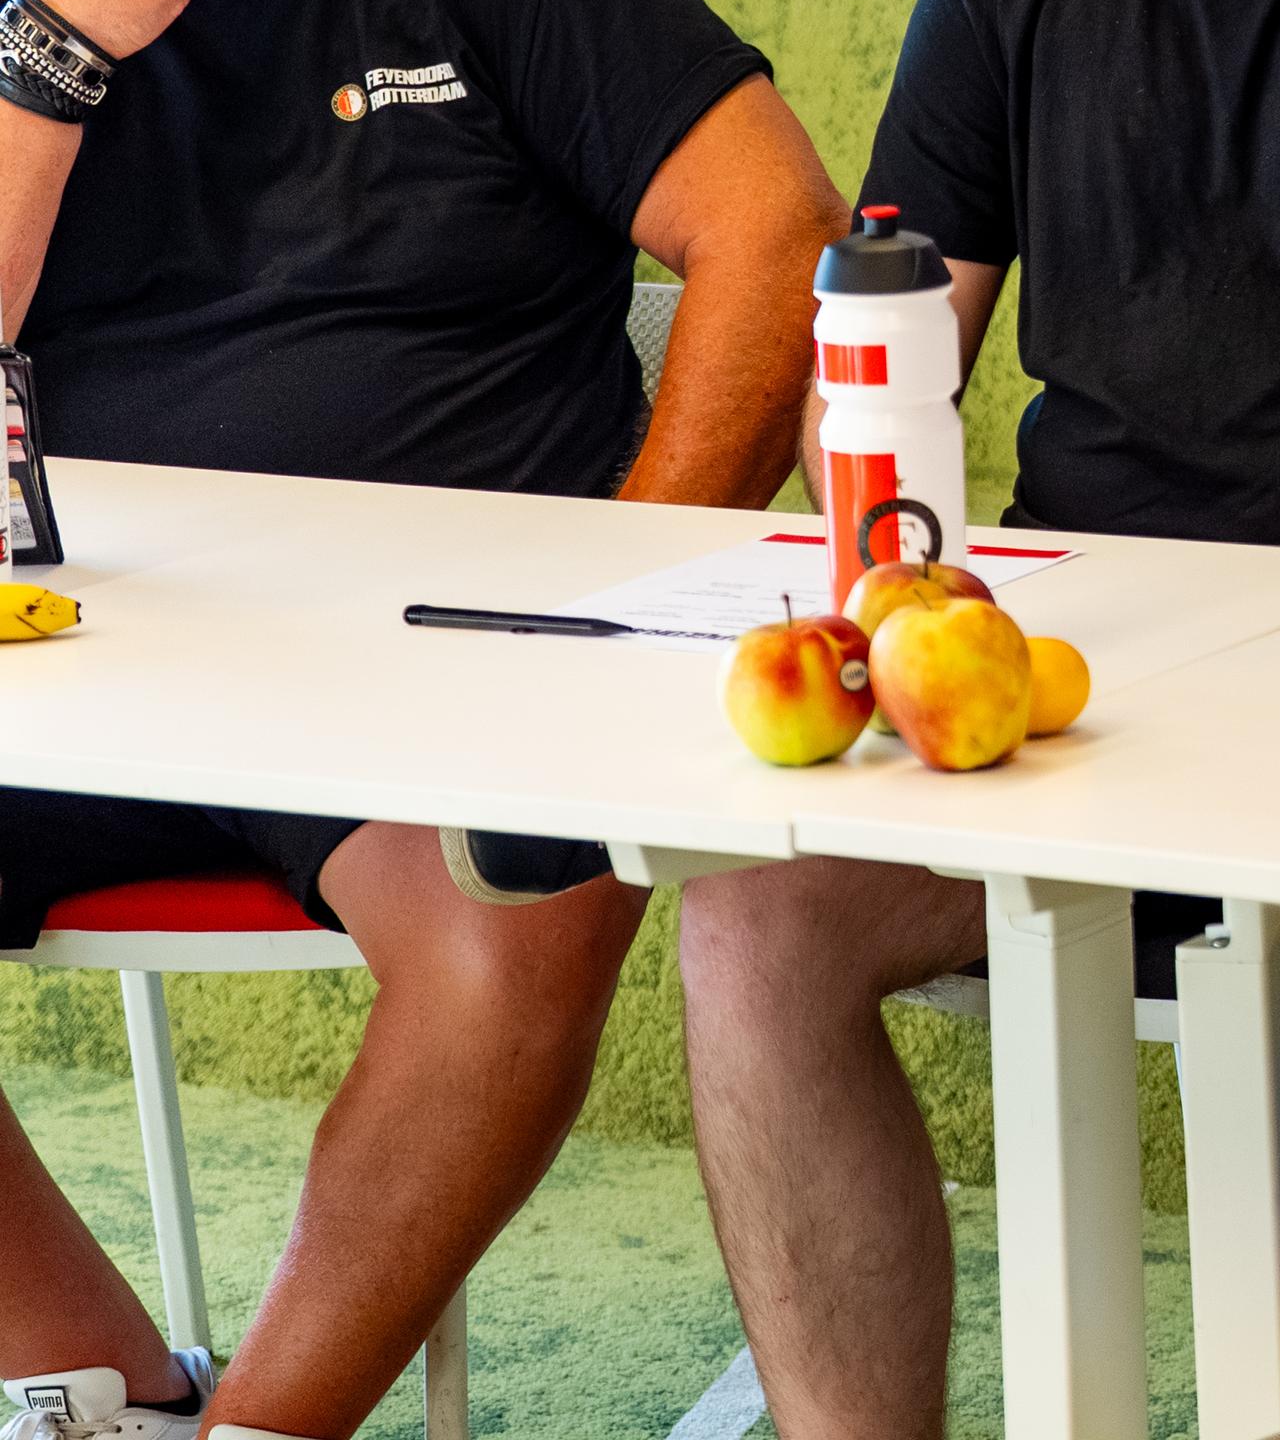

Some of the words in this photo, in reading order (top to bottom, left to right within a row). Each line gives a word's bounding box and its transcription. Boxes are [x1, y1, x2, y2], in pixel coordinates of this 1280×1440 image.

[364, 62, 457, 91] FEYENOORD
[369, 80, 468, 112] ROTTERDAM
[31, 1396, 63, 1408] PUMA
